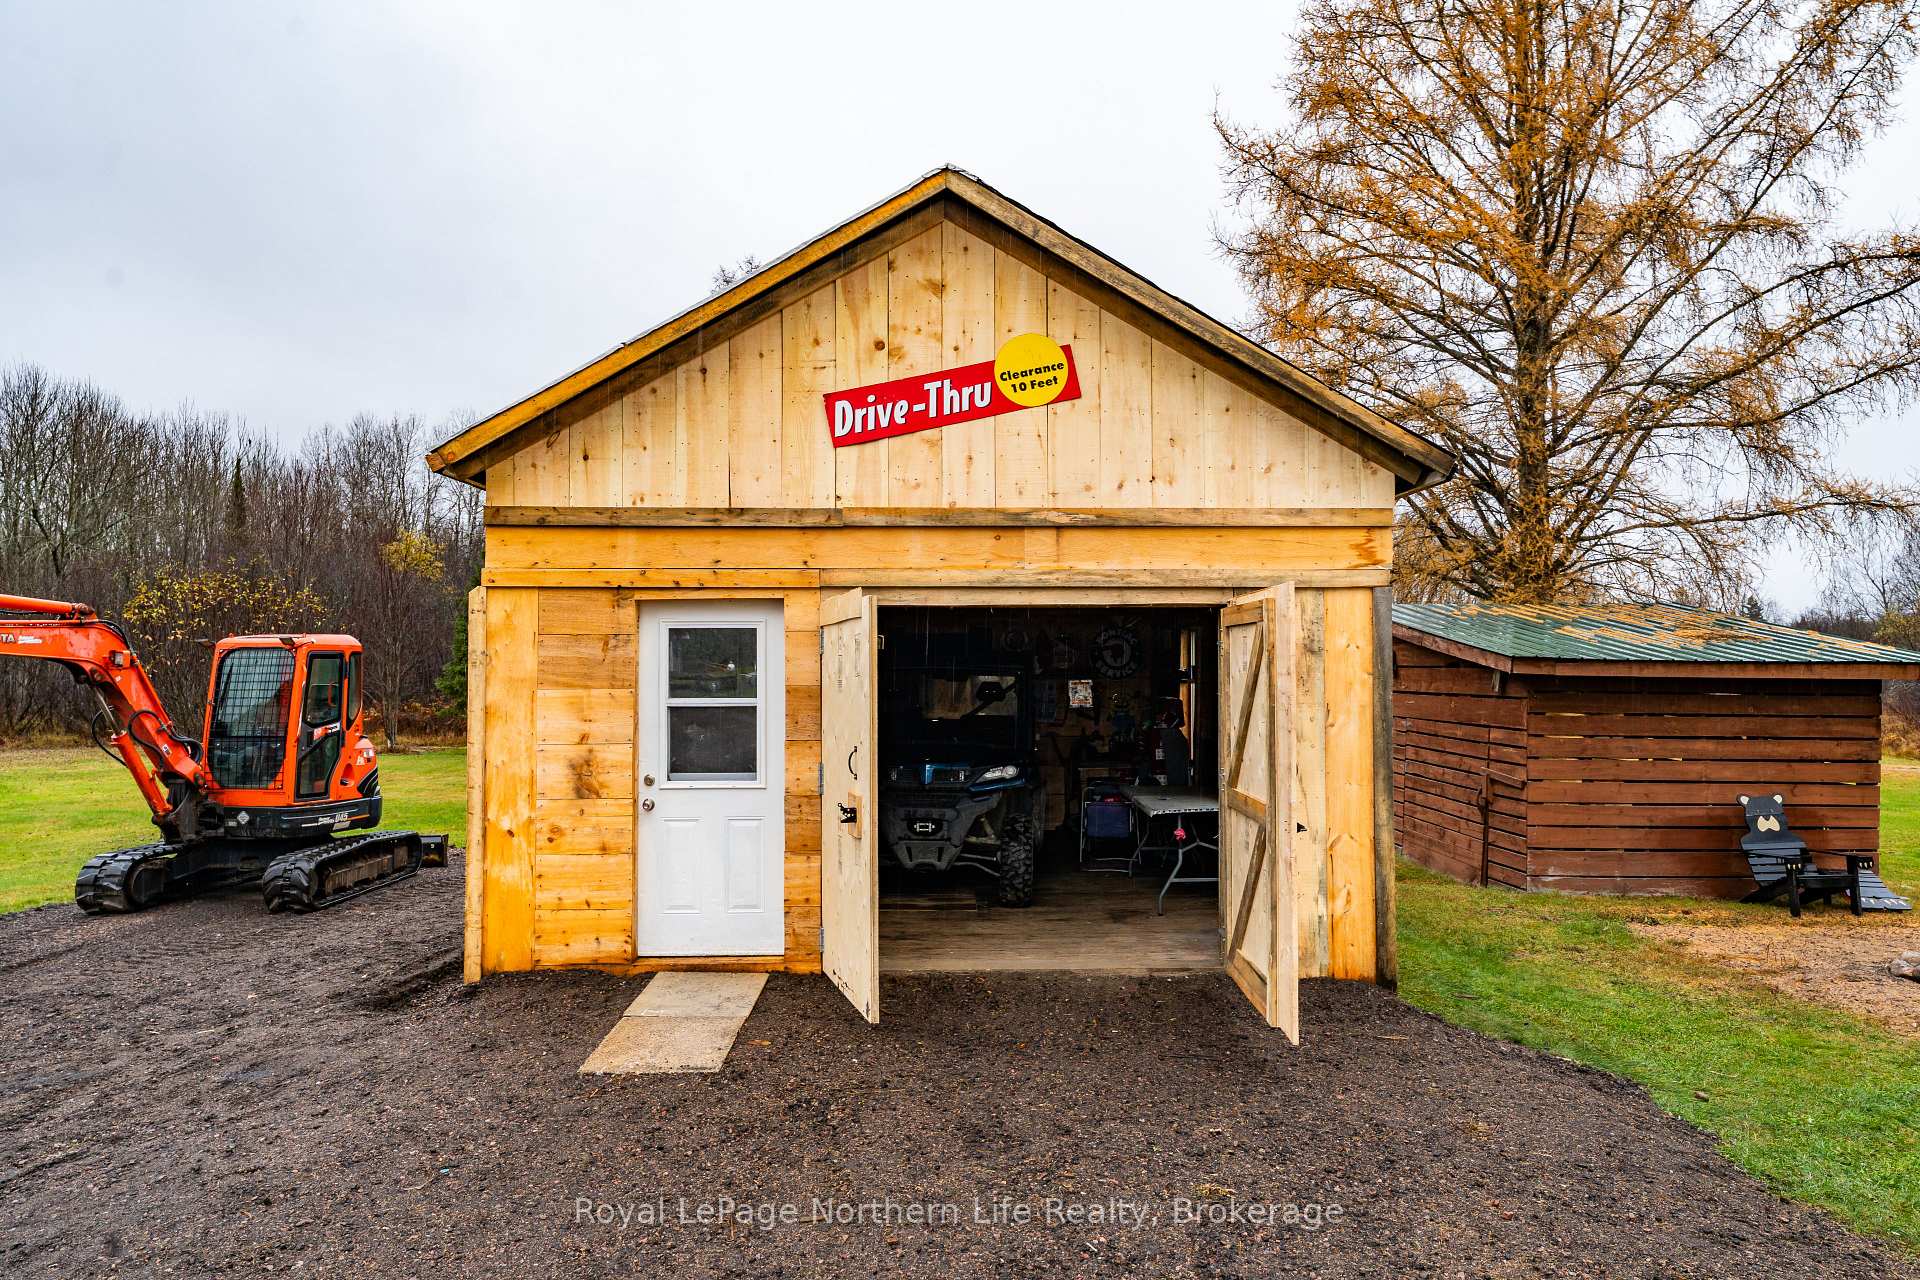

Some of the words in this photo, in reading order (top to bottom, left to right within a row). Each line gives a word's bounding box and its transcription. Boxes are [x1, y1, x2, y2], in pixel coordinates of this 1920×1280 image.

[1000, 362, 1064, 382] Clearance
[1011, 382, 1027, 393] 10
[1030, 375, 1058, 390] Feet
[834, 379, 992, 437] Drive-Thru
